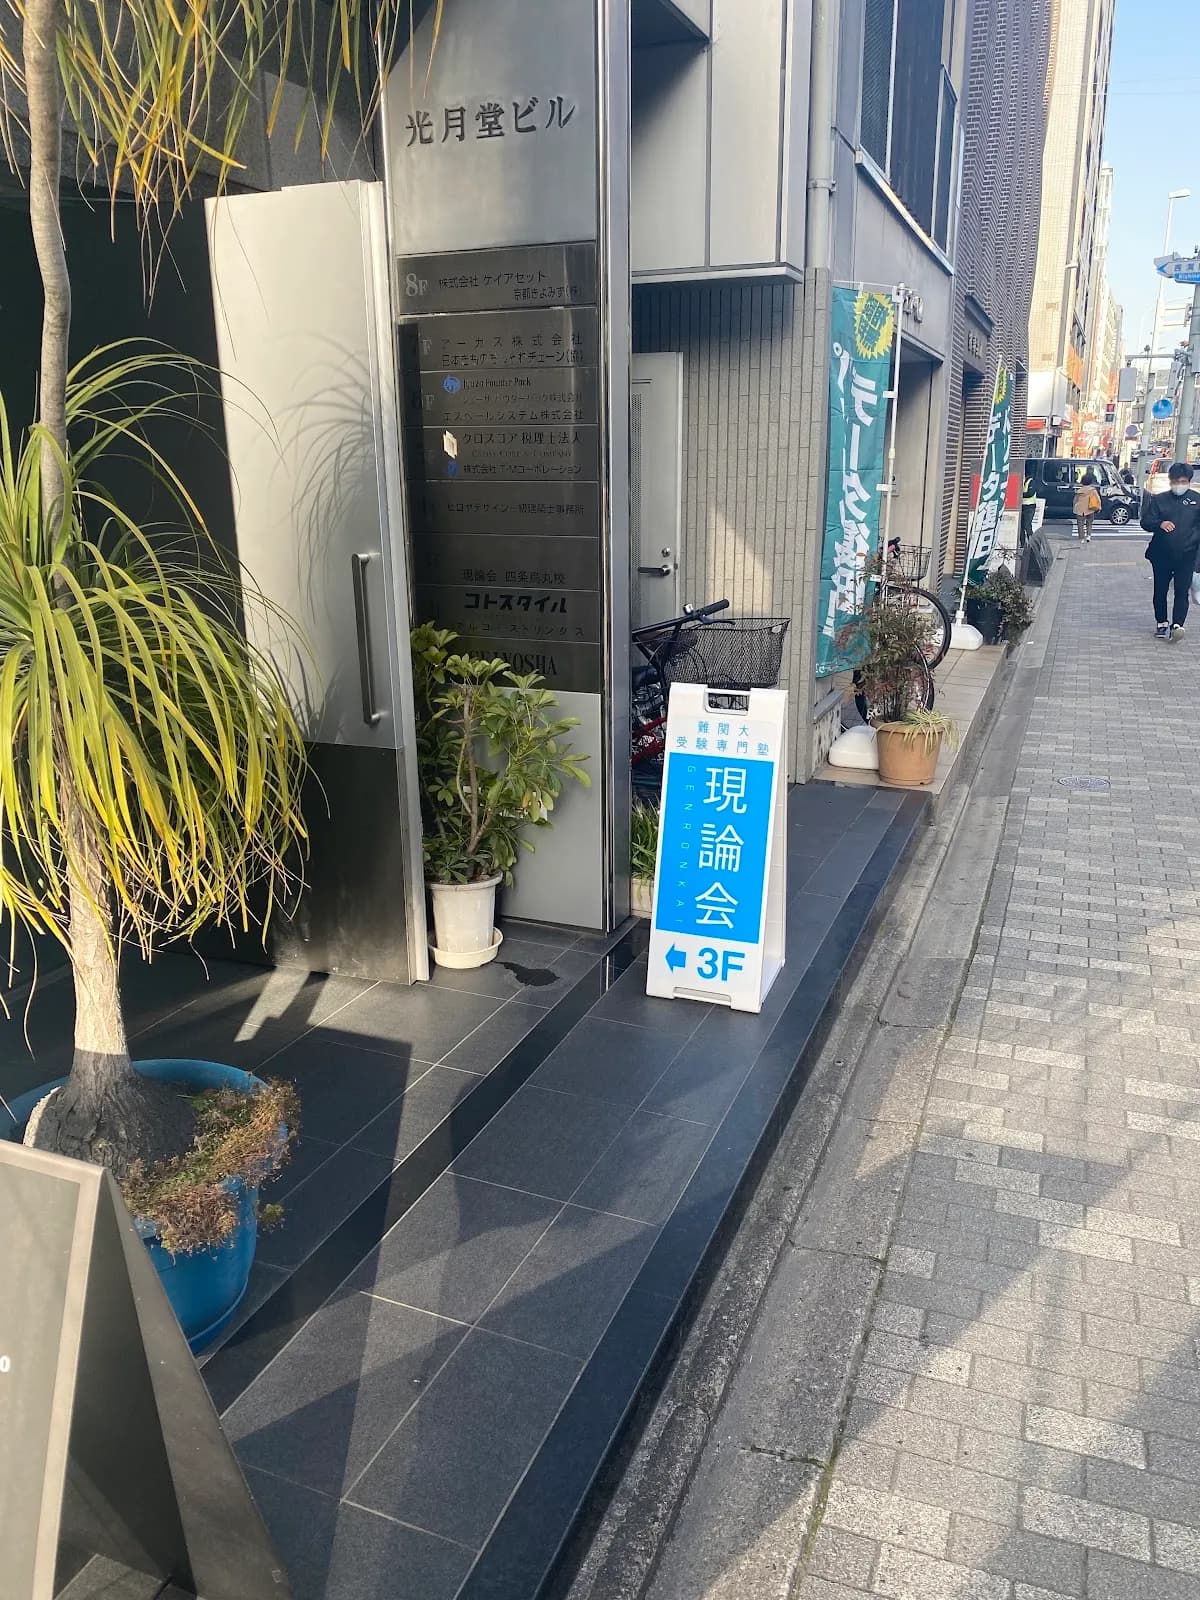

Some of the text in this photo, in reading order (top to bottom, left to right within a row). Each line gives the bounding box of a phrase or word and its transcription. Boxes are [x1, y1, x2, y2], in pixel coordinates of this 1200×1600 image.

[405, 96, 576, 147] 光月堂ビル
[405, 273, 428, 297] 8F
[463, 592, 568, 614] コトスタイル
[698, 720, 750, 737] 難関大
[676, 736, 769, 756] 受験専門塾
[675, 764, 697, 923] GENRONKAI
[694, 765, 748, 930] 現論会
[696, 947, 746, 982] 3F
